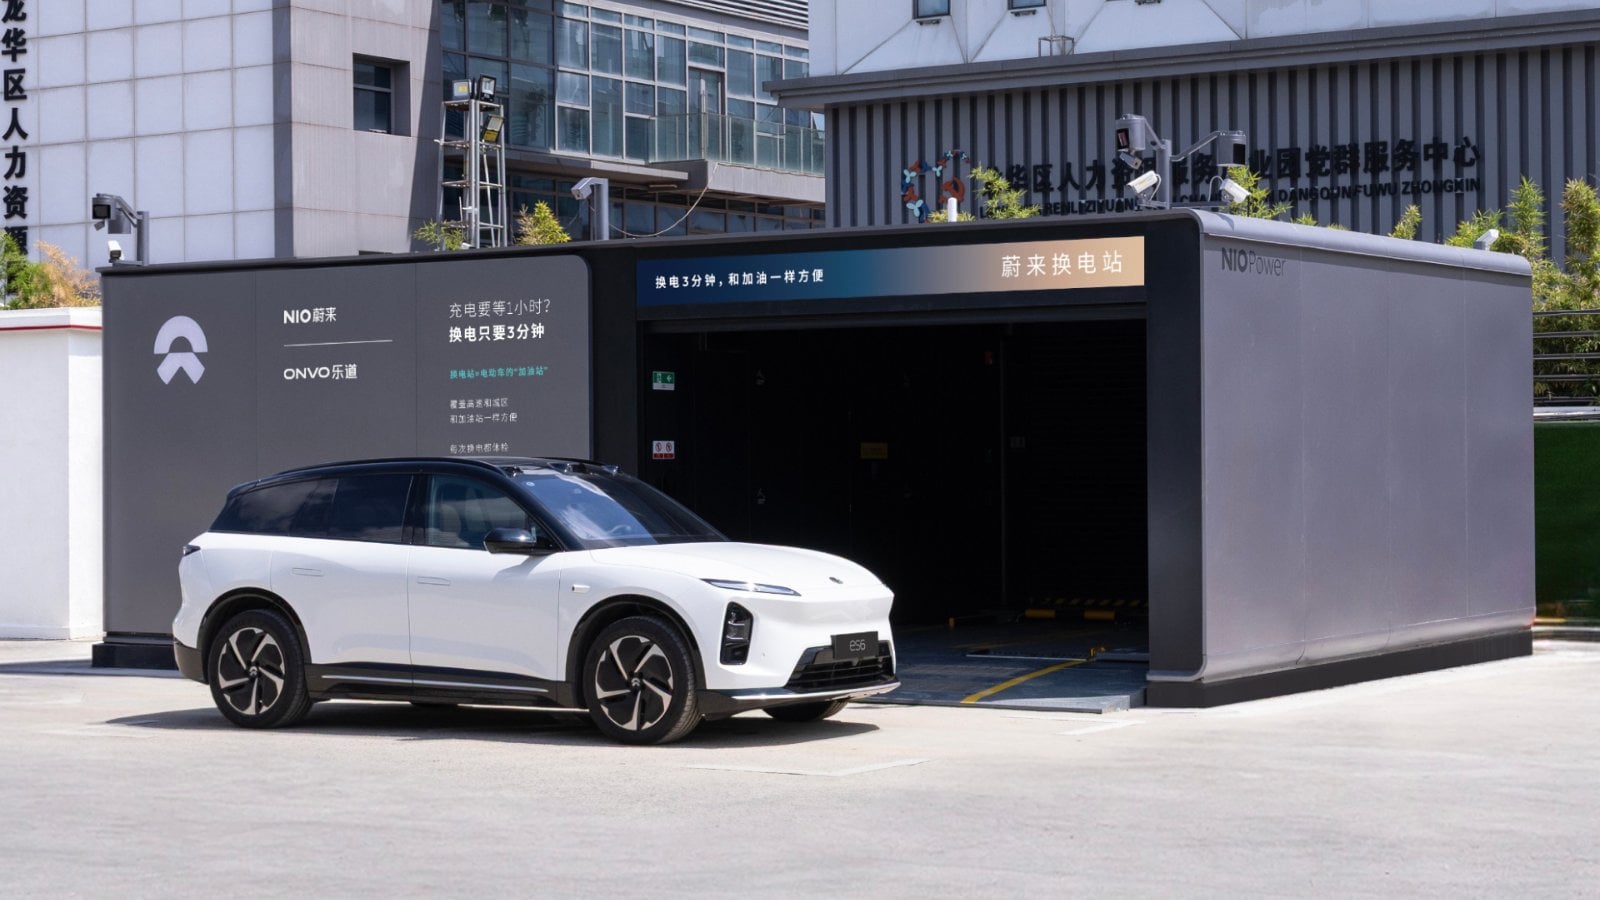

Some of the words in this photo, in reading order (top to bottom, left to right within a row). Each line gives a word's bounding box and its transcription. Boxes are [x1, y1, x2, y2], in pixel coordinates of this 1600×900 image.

[1402, 177, 1480, 195] ZHONGXIN
[1001, 249, 1124, 280] 蔚来换电站
[654, 268, 825, 290] 换电3分钟，和加油一样方便
[448, 298, 551, 320] 充电要等1小时？
[448, 322, 545, 344] 换电只要3分钟
